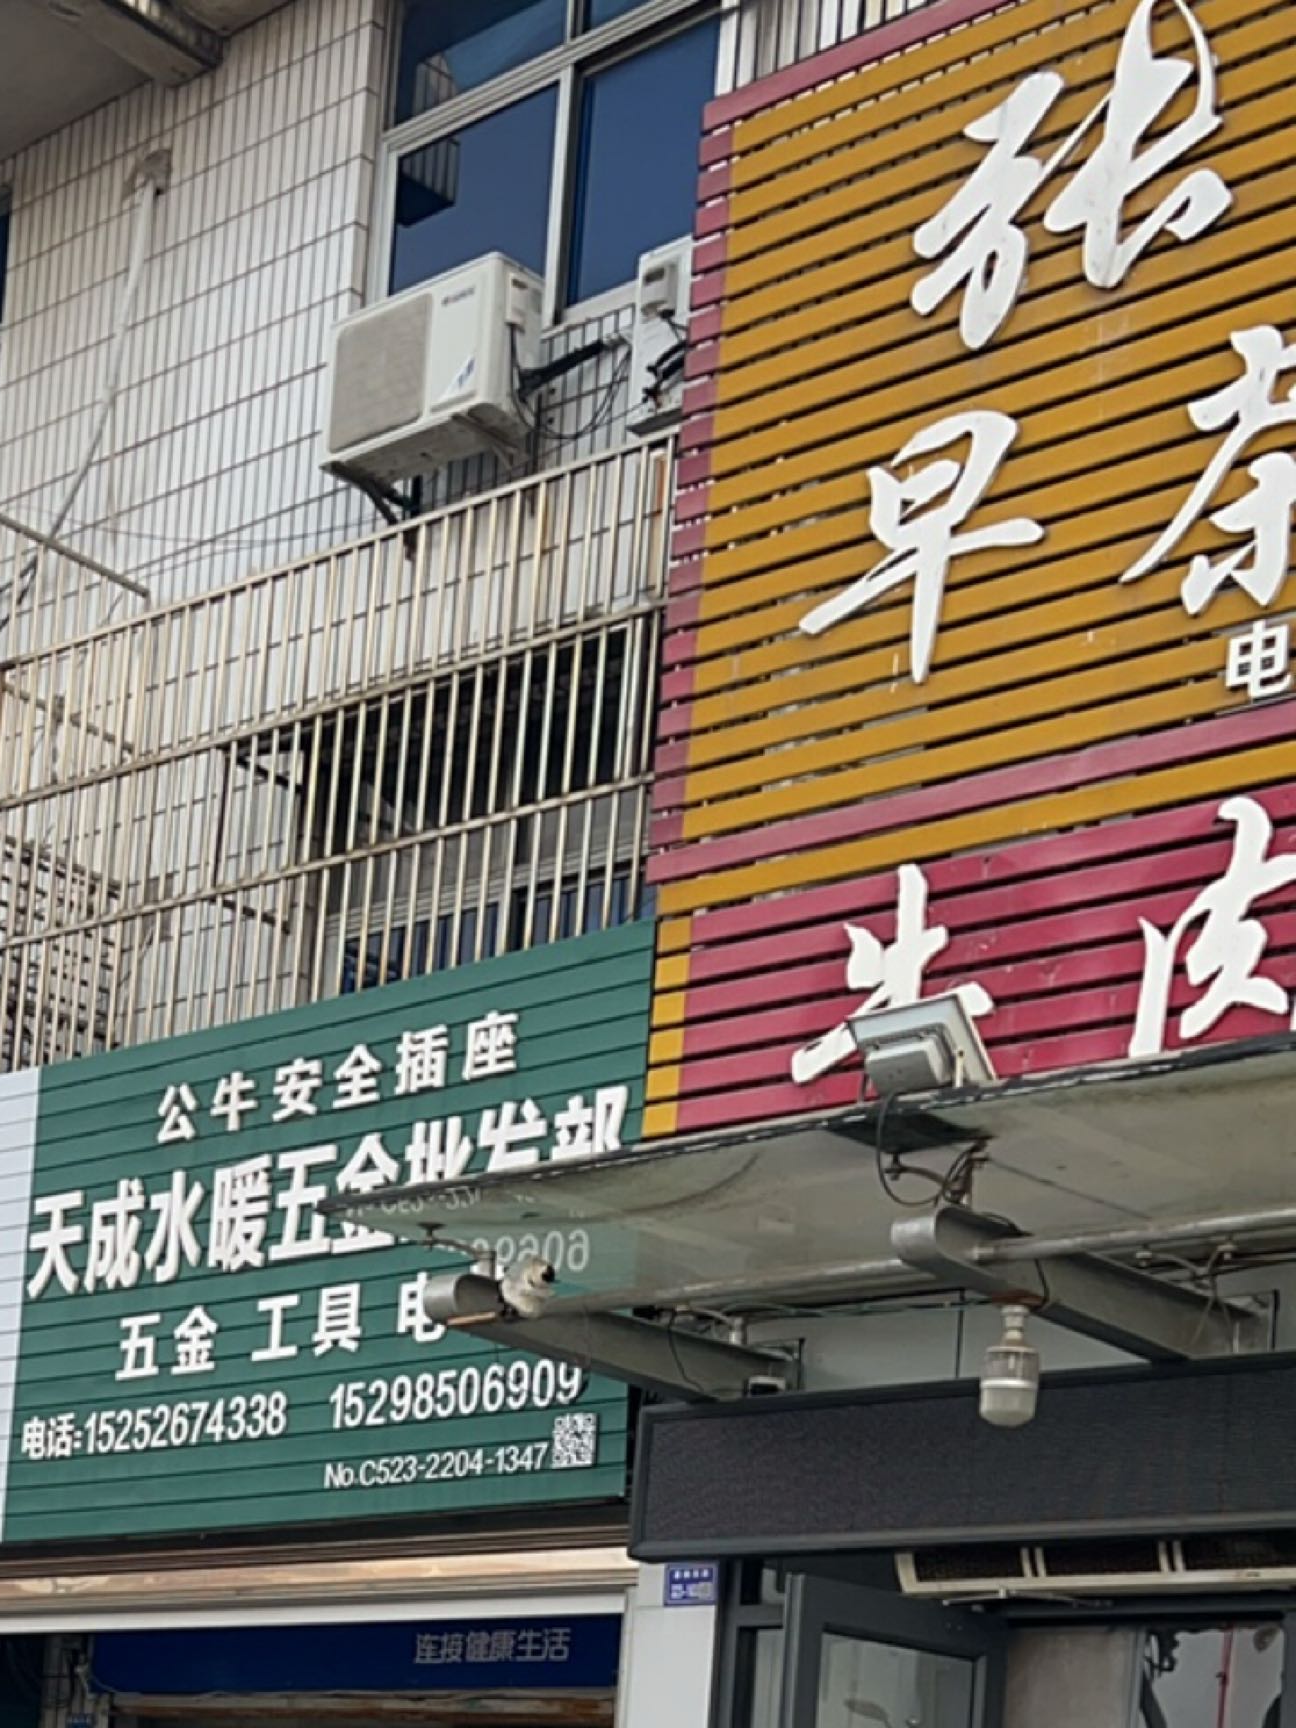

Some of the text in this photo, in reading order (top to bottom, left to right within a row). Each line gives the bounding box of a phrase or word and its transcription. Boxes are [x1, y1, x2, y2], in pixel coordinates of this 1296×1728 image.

[156, 1011, 519, 1143] 公牛安全插座
[331, 1360, 581, 1429] 15298506909
[414, 1628, 572, 1664] 连接健康生活
